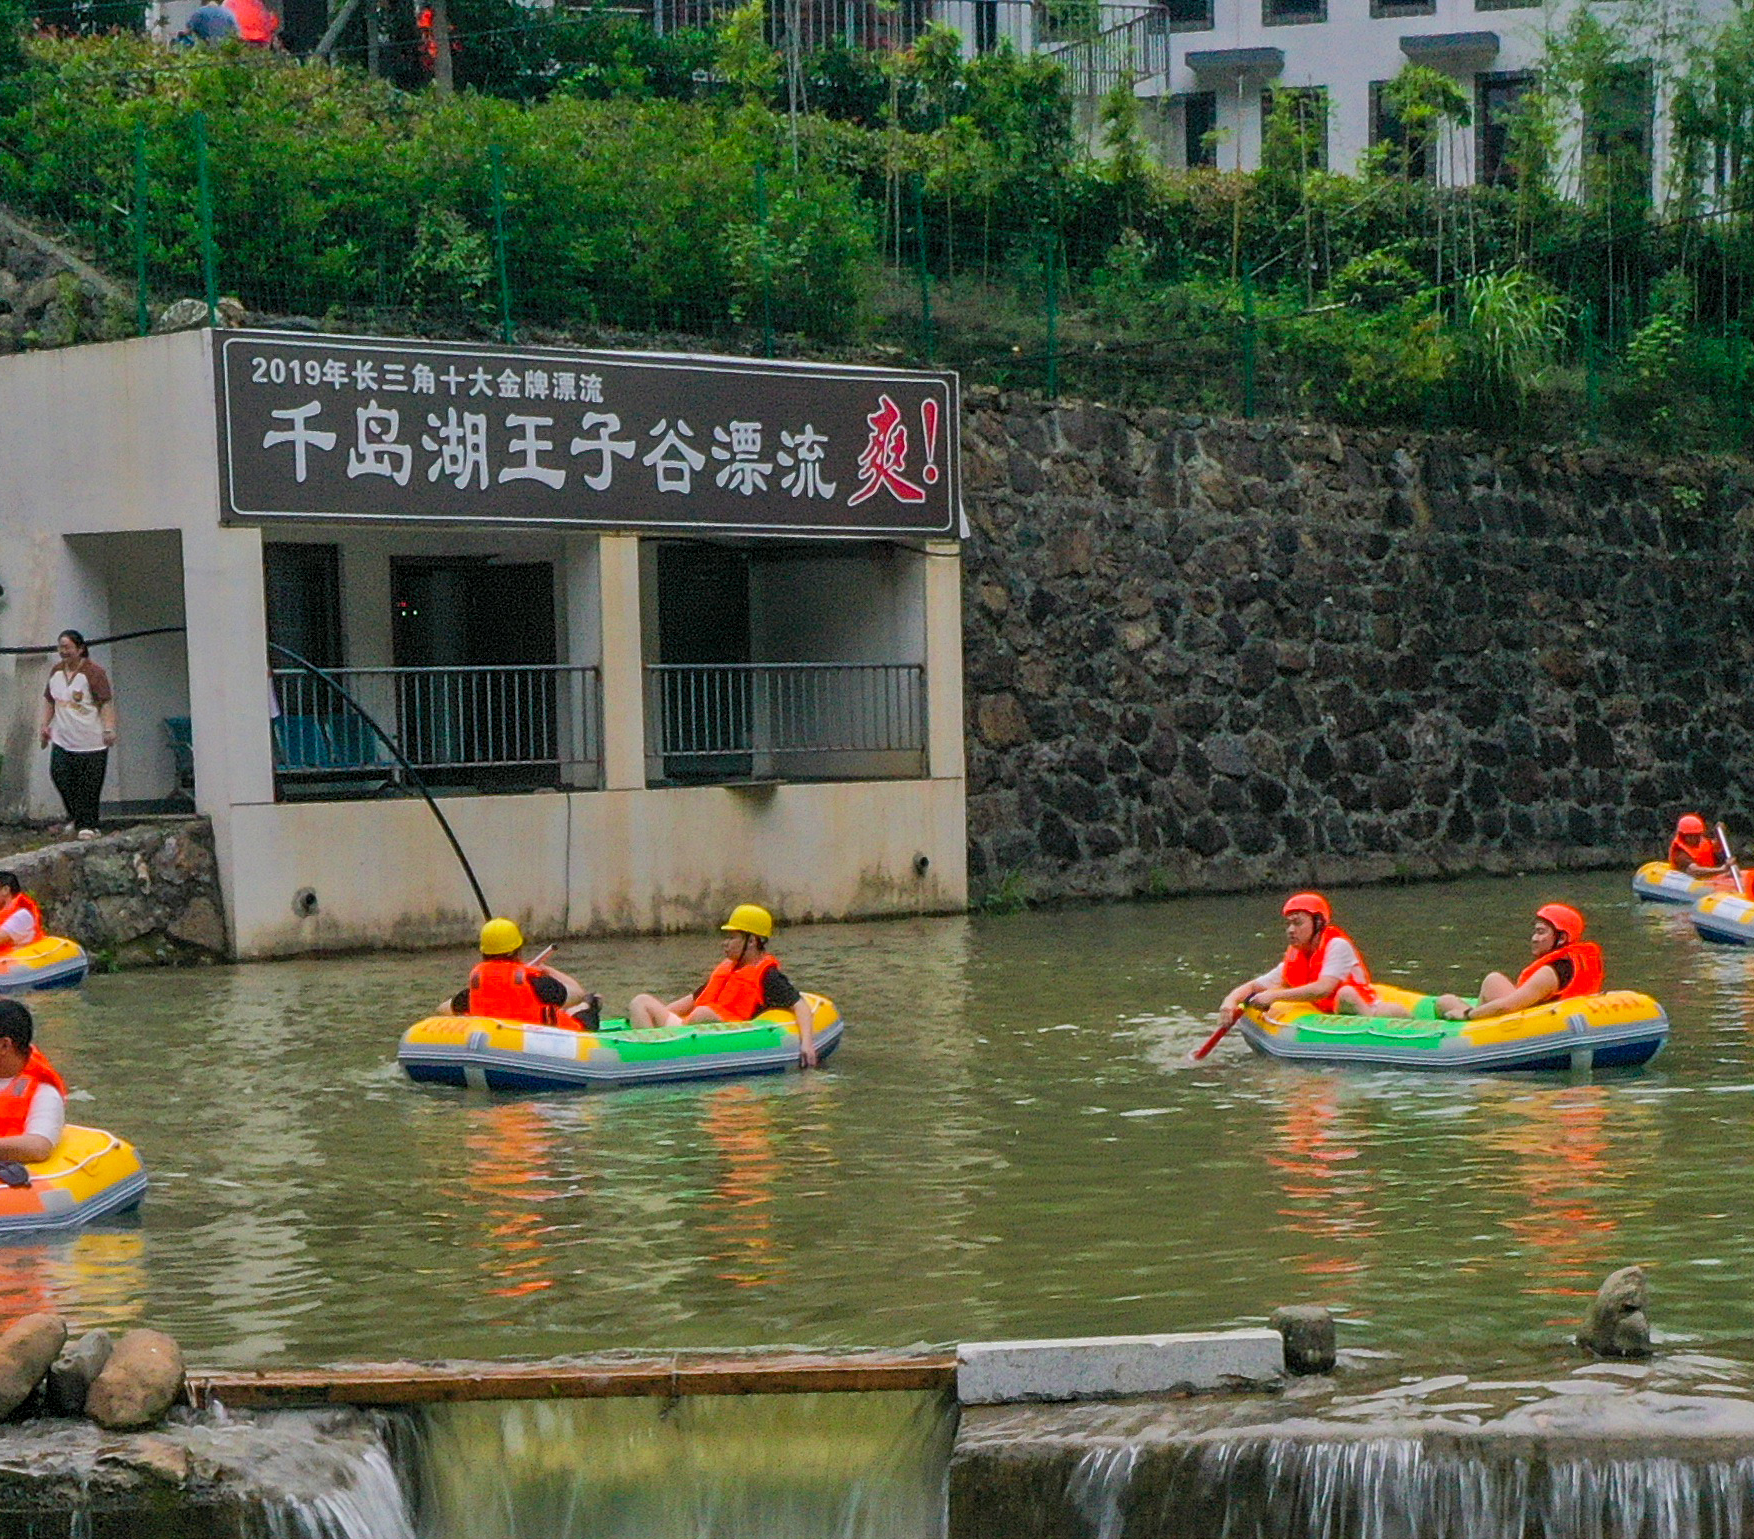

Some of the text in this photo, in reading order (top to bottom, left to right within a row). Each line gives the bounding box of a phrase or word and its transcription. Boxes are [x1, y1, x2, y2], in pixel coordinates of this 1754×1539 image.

[251, 356, 604, 403] 2019年长三角十大金牌漂流
[262, 399, 837, 499] 千岛湖王子谷漂流
